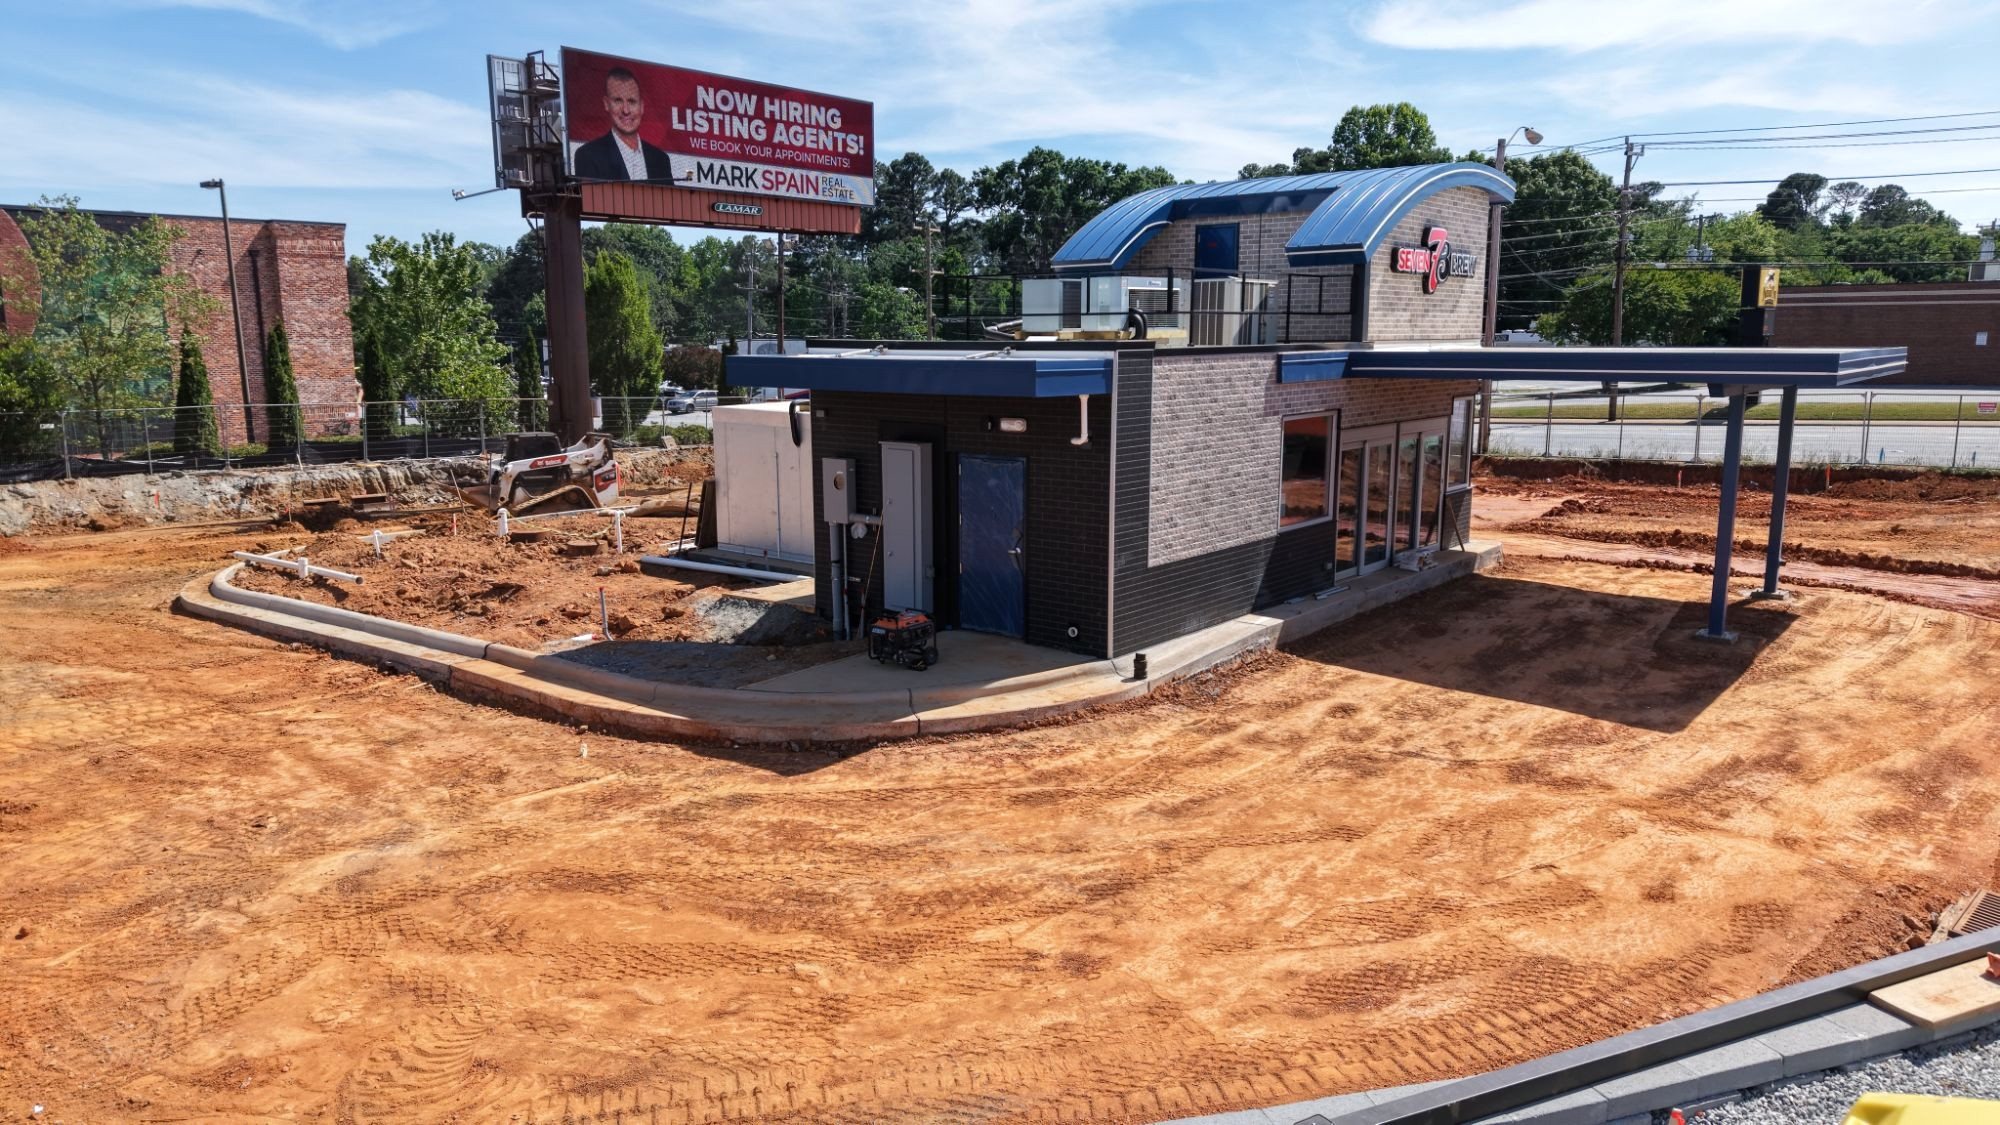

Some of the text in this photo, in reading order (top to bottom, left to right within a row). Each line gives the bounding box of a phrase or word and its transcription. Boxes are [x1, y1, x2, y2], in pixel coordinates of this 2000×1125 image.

[697, 85, 841, 129] NOW HIRING
[671, 106, 865, 156] LISTING AGENTS!
[689, 136, 849, 168] WE BOOK YOUR APPOINTMENTS!
[697, 161, 819, 196] MARK SPAIN
[821, 176, 846, 188] REAL
[822, 187, 855, 200] ESTATE
[718, 203, 760, 215] LAMAR
[1398, 248, 1431, 273] SEVEN
[1450, 253, 1477, 276] BREW
